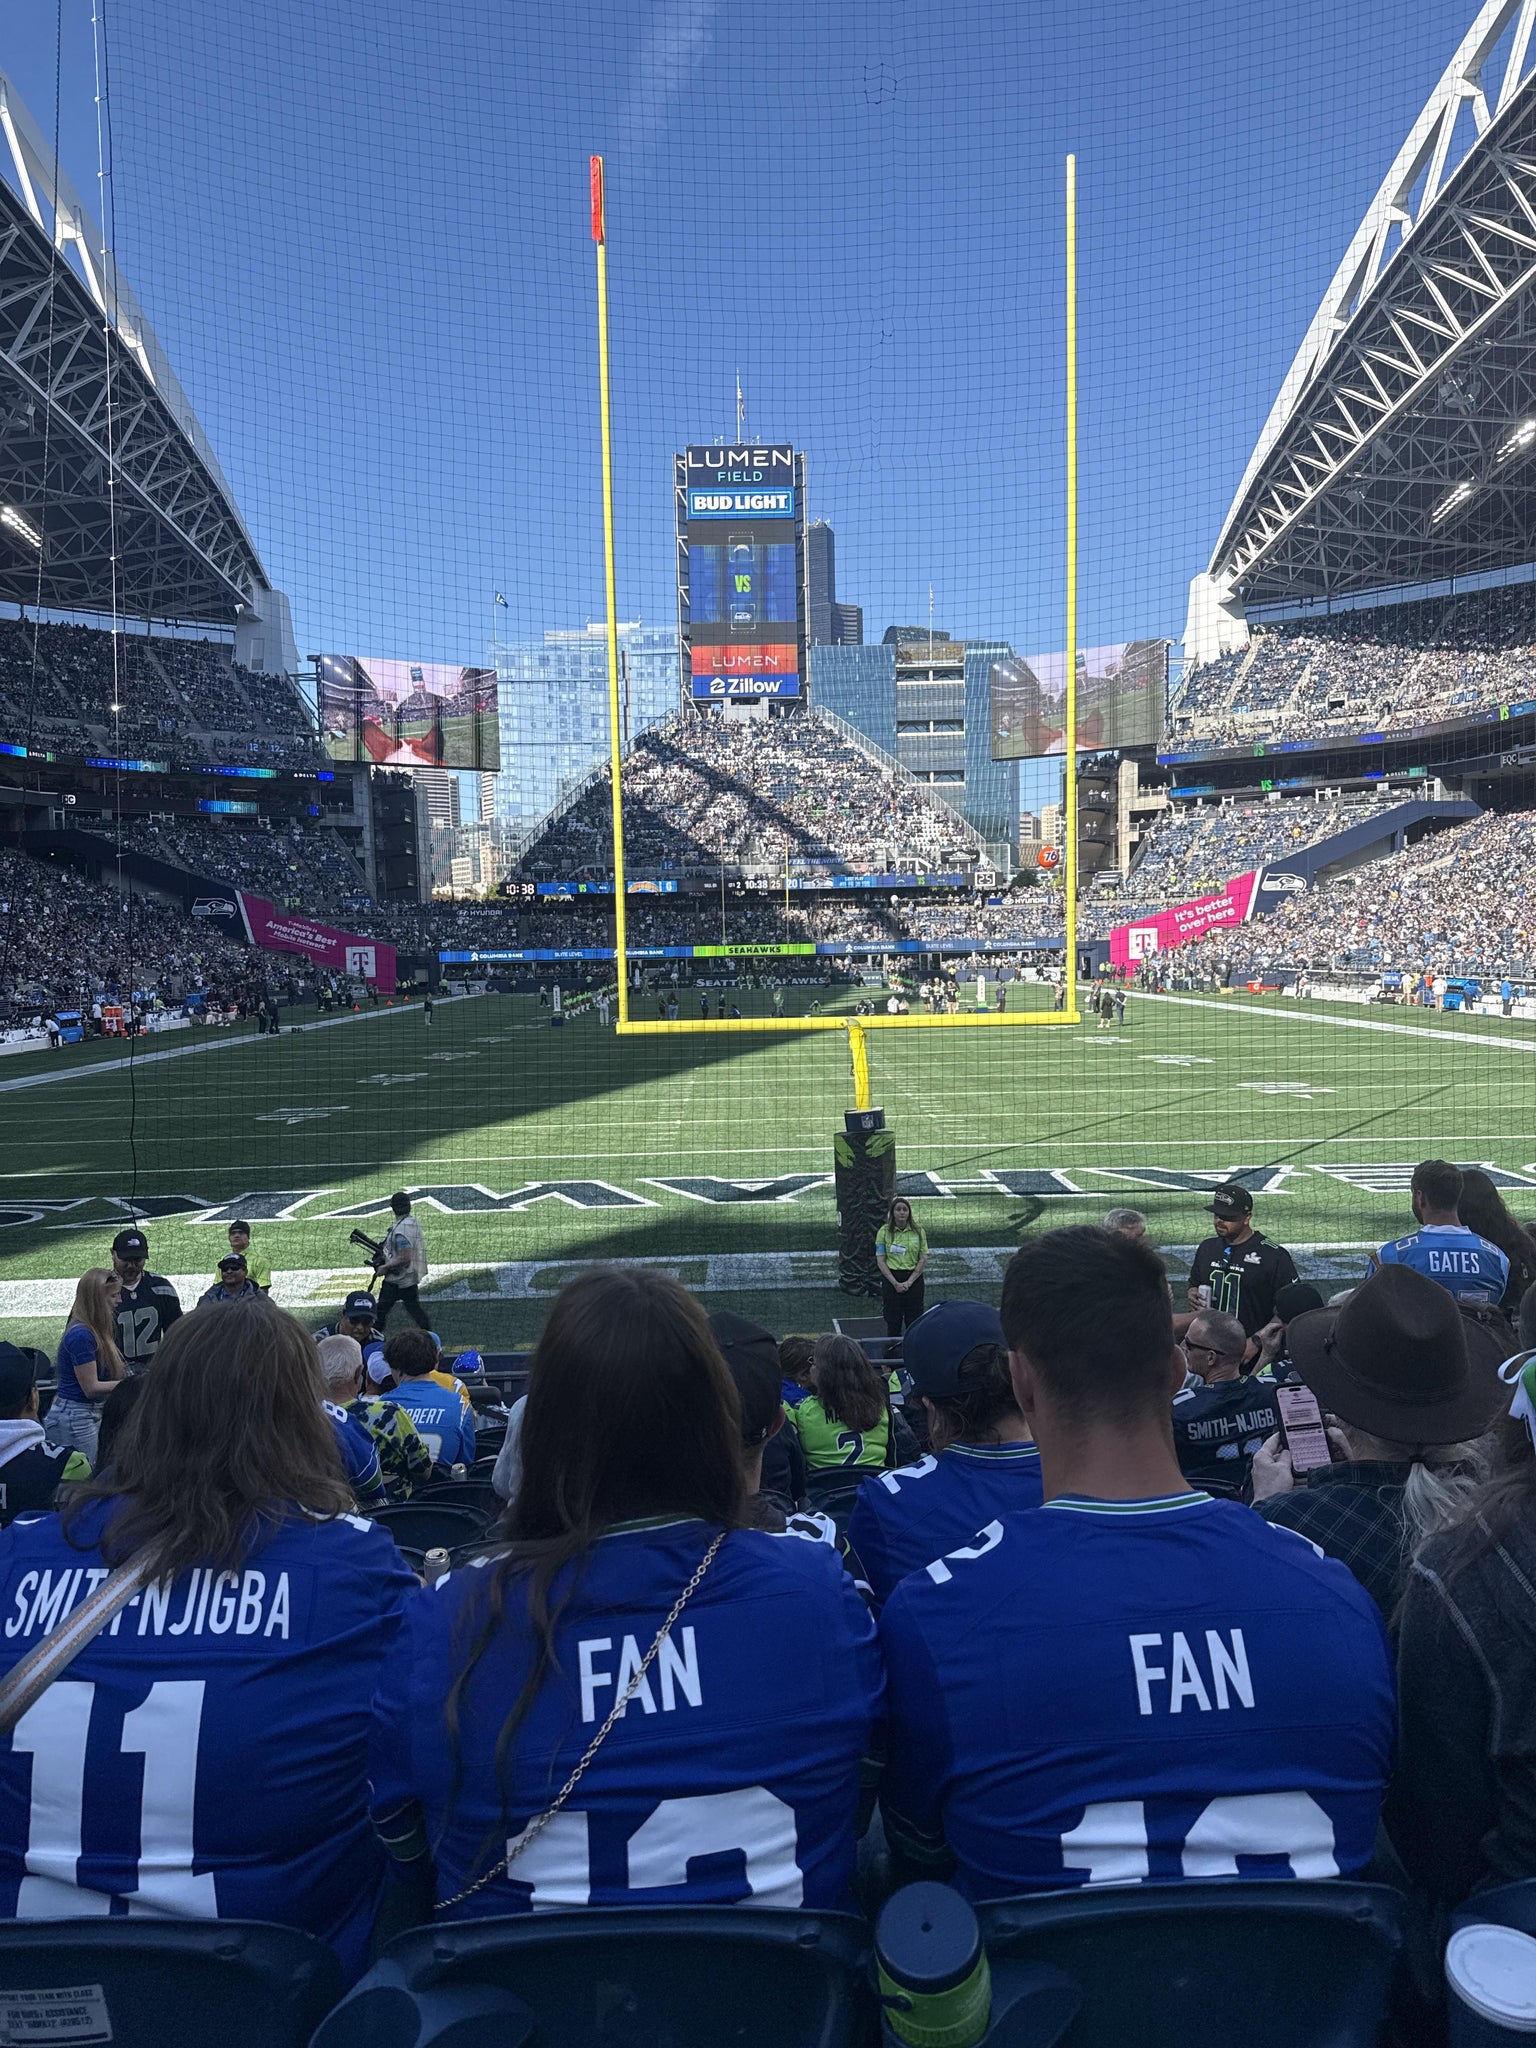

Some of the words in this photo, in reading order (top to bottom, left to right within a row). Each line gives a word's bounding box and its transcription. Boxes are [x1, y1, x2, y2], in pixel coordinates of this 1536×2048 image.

[688, 450, 792, 468] LUMEN
[717, 471, 763, 482] FIELD
[694, 496, 732, 510] BUD
[735, 494, 787, 509] LIGHT
[734, 574, 751, 592] VS
[712, 655, 777, 667] LUMEN
[728, 678, 779, 694] Zillow
[1500, 705, 1509, 720] VS
[250, 743, 258, 751] 12
[1253, 744, 1264, 756] VS
[1502, 753, 1518, 765] EQC
[1261, 780, 1272, 791] VS
[1044, 851, 1057, 862] 76
[666, 881, 672, 890] 6
[736, 881, 741, 889] 2
[744, 880, 768, 889] 10:38
[771, 880, 781, 889] 25
[787, 878, 798, 888] 20
[978, 875, 991, 885] 25
[506, 884, 535, 895] 10:38
[1174, 910, 1194, 922] It's
[1195, 896, 1234, 917] better
[1179, 919, 1205, 933] over
[1207, 908, 1236, 923] here
[265, 920, 314, 939] America's
[315, 934, 337, 946] Best
[273, 930, 296, 942] Mobile
[297, 937, 326, 950] Network
[729, 946, 781, 954] SEAHAWKS
[1429, 1251, 1479, 1274] GATES
[1210, 1270, 1241, 1318] 11
[117, 1305, 159, 1358] 12
[1187, 1408, 1278, 1441] SMITH-NJIGB
[836, 1430, 865, 1465] 2
[578, 1626, 703, 1723] FAN
[1129, 1628, 1255, 1715] FAN
[12, 1680, 218, 1918] 11
[45, 2006, 87, 2018] ASSISTANCE
